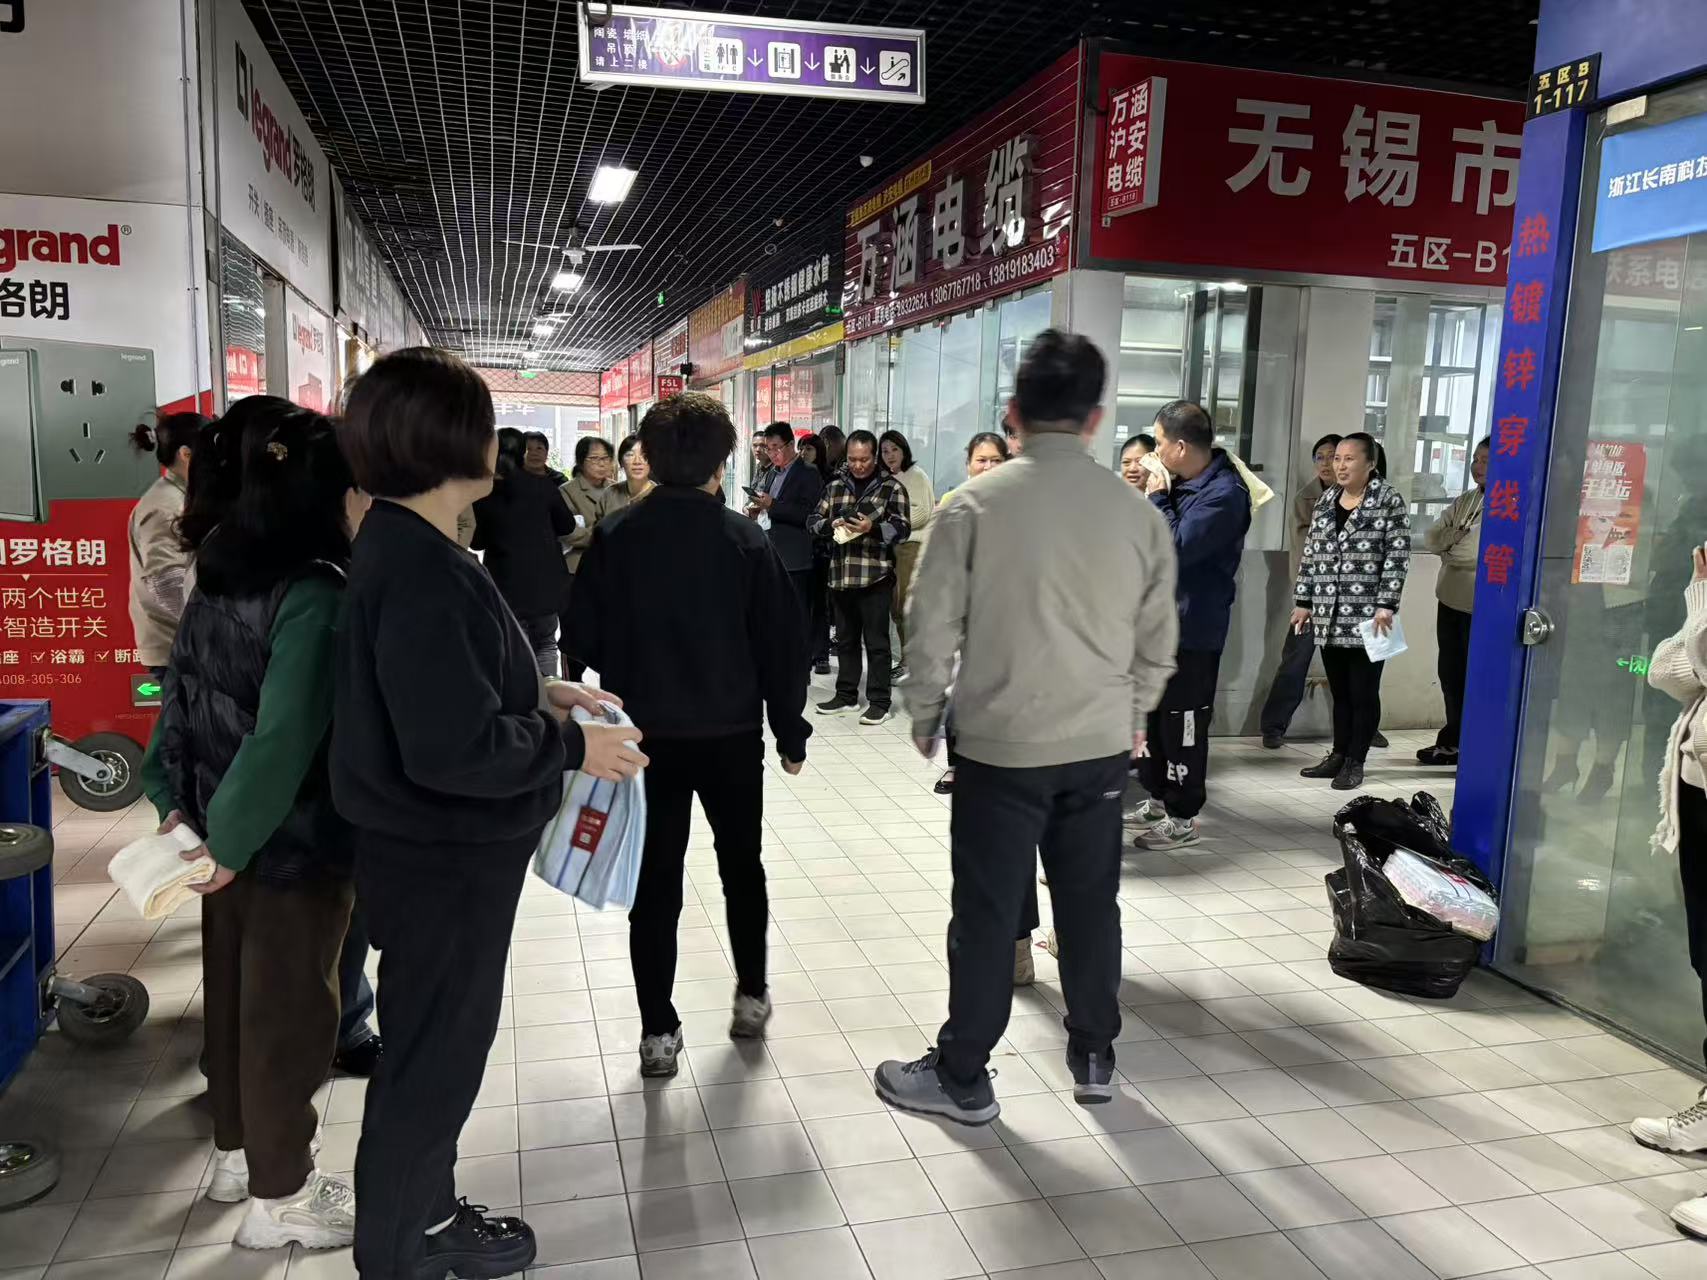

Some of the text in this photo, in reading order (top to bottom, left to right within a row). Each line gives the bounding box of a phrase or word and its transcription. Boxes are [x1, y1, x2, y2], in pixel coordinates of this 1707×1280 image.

[594, 54, 648, 71] 请上二楼
[1111, 81, 1149, 126] 万涵
[1533, 78, 1590, 115] 1-117
[1109, 120, 1147, 160] 沪安
[1224, 96, 1524, 216] 无锡市
[1106, 154, 1145, 194] 电缆
[988, 244, 1055, 287] 13819183403
[661, 378, 679, 387] FSL
[0, 538, 107, 567] 罗格朗
[1, 586, 108, 610] 两个世纪
[0, 615, 109, 639] 智造开关
[50, 648, 86, 665] 浴霸
[0, 673, 82, 686] 008-305-306
